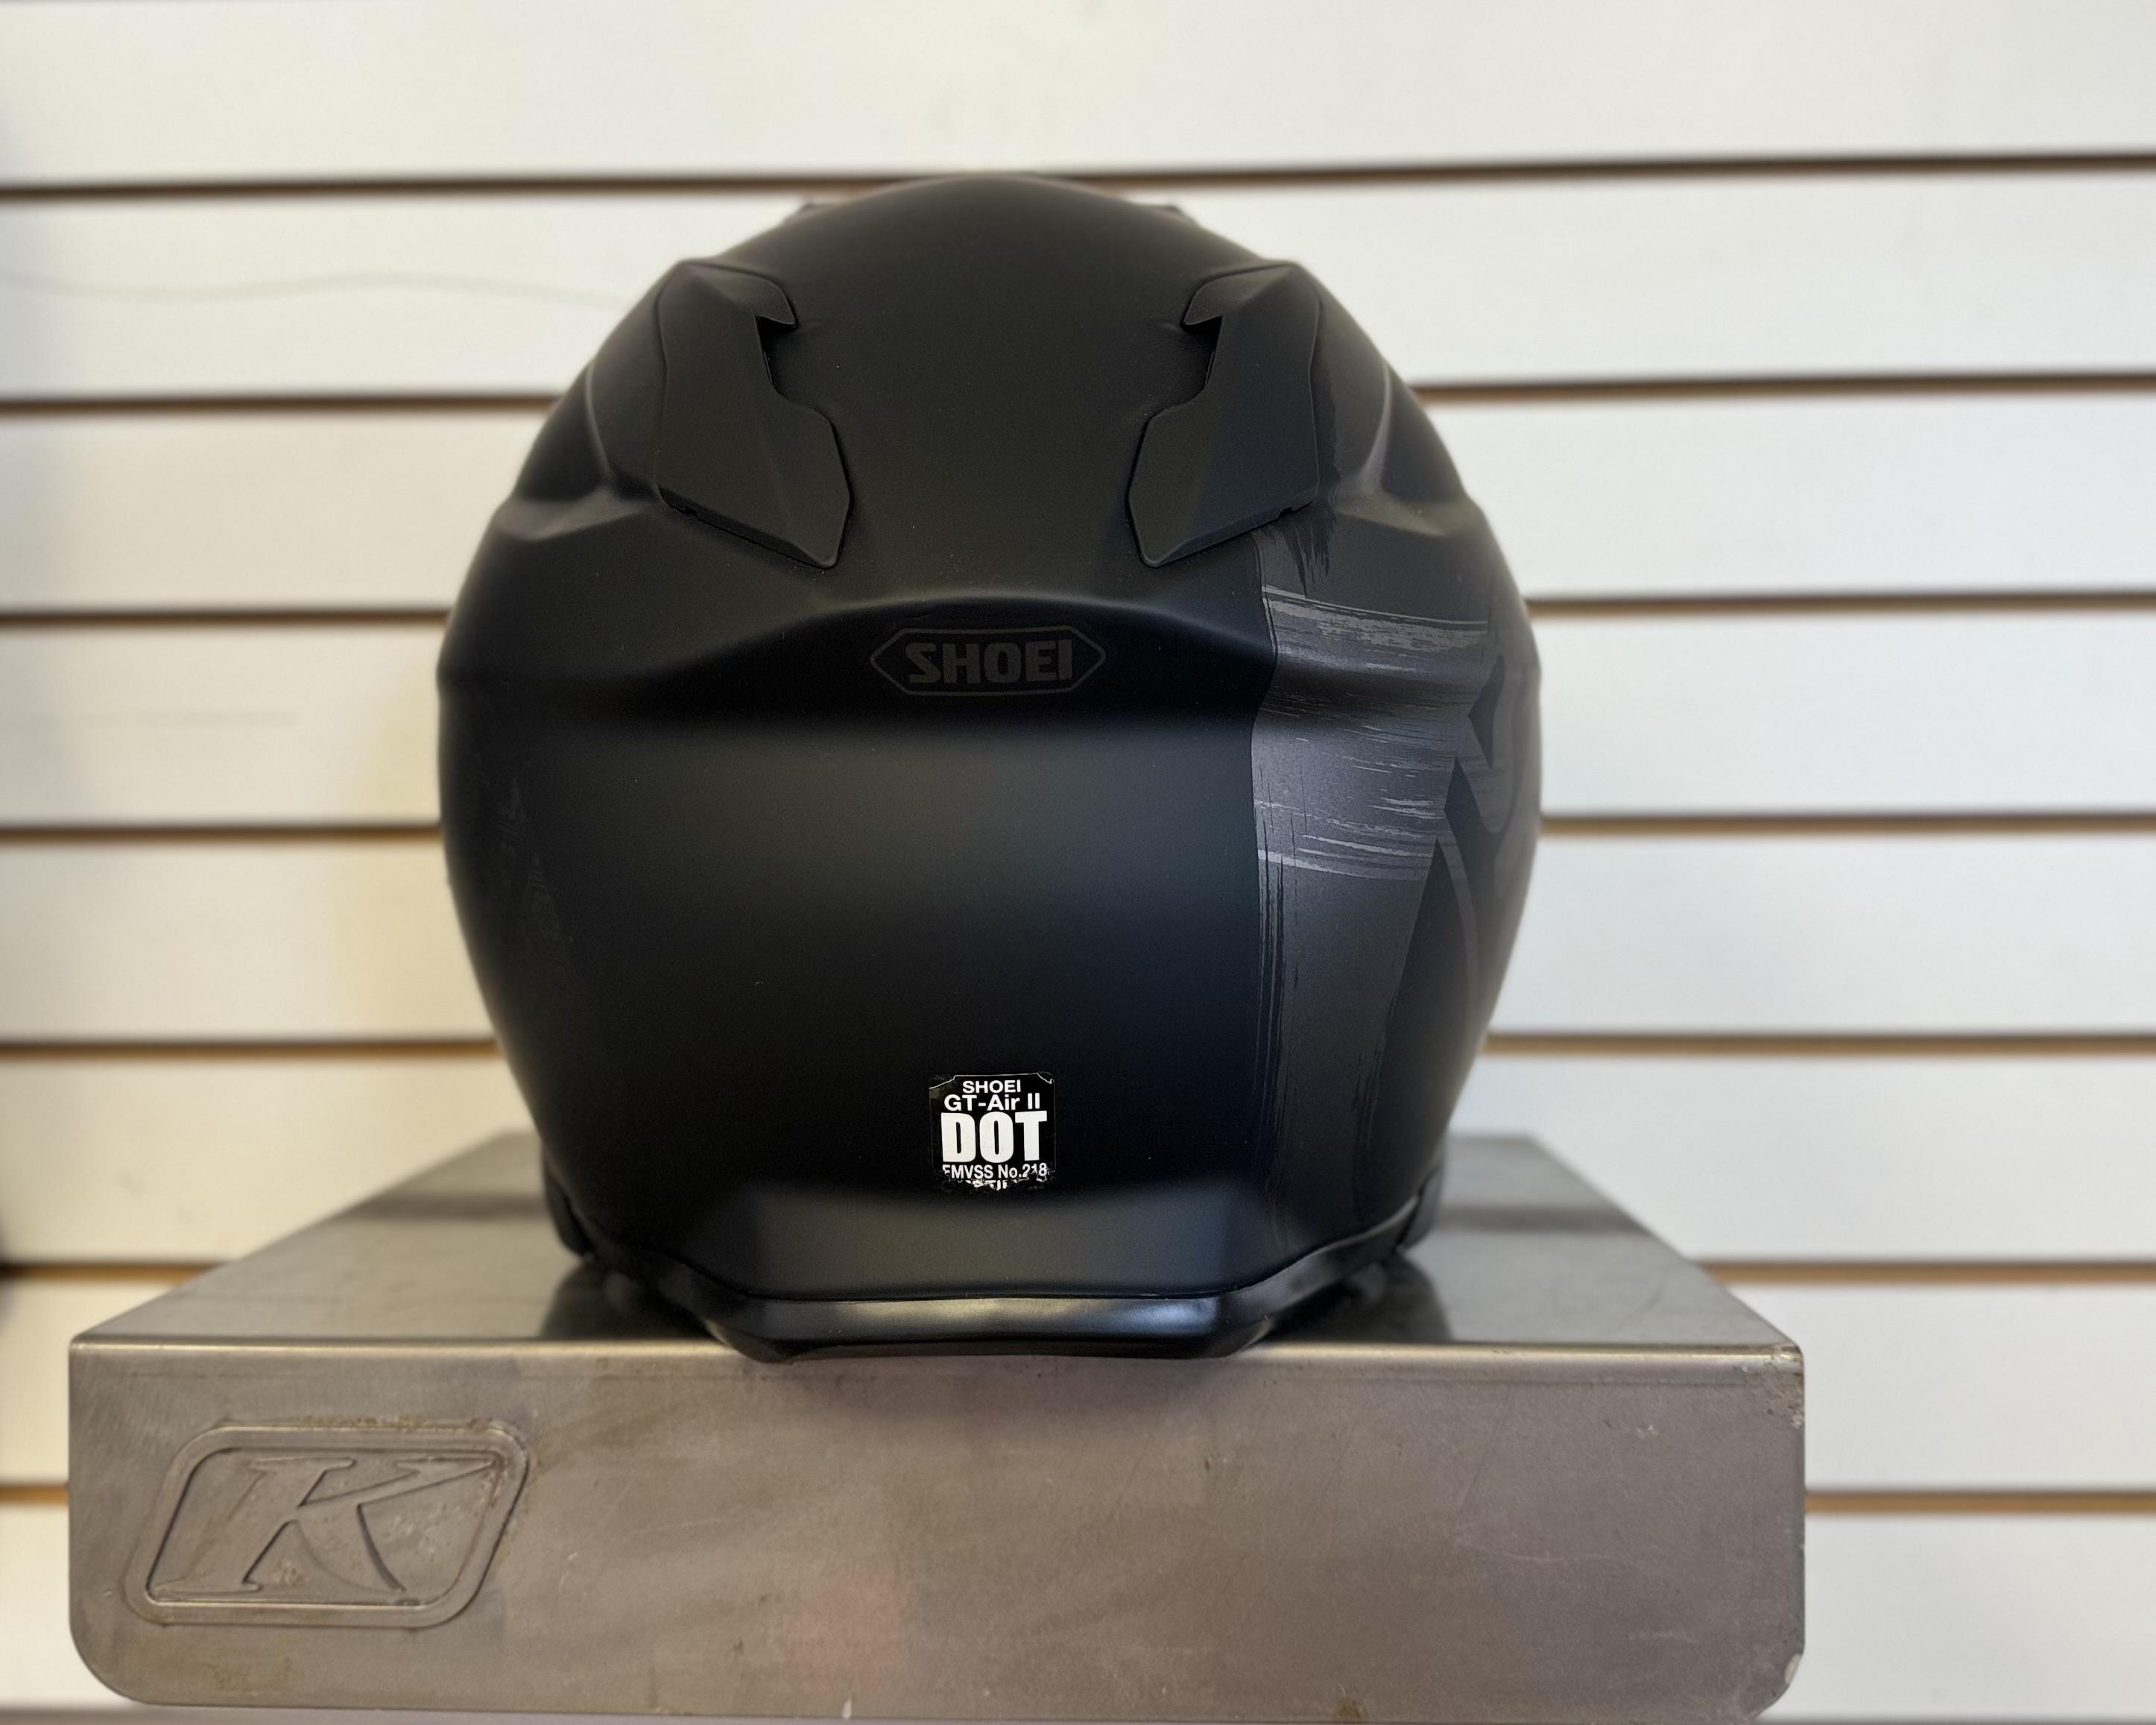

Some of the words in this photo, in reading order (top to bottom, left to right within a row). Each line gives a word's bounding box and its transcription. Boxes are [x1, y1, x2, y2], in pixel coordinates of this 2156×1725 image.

[905, 640, 1072, 684] SHOEI
[963, 1079, 1021, 1094] SHOEI
[944, 1094, 1020, 1111] GT-Air
[941, 1111, 1047, 1163] DOT
[943, 1164, 993, 1179] FMVSS
